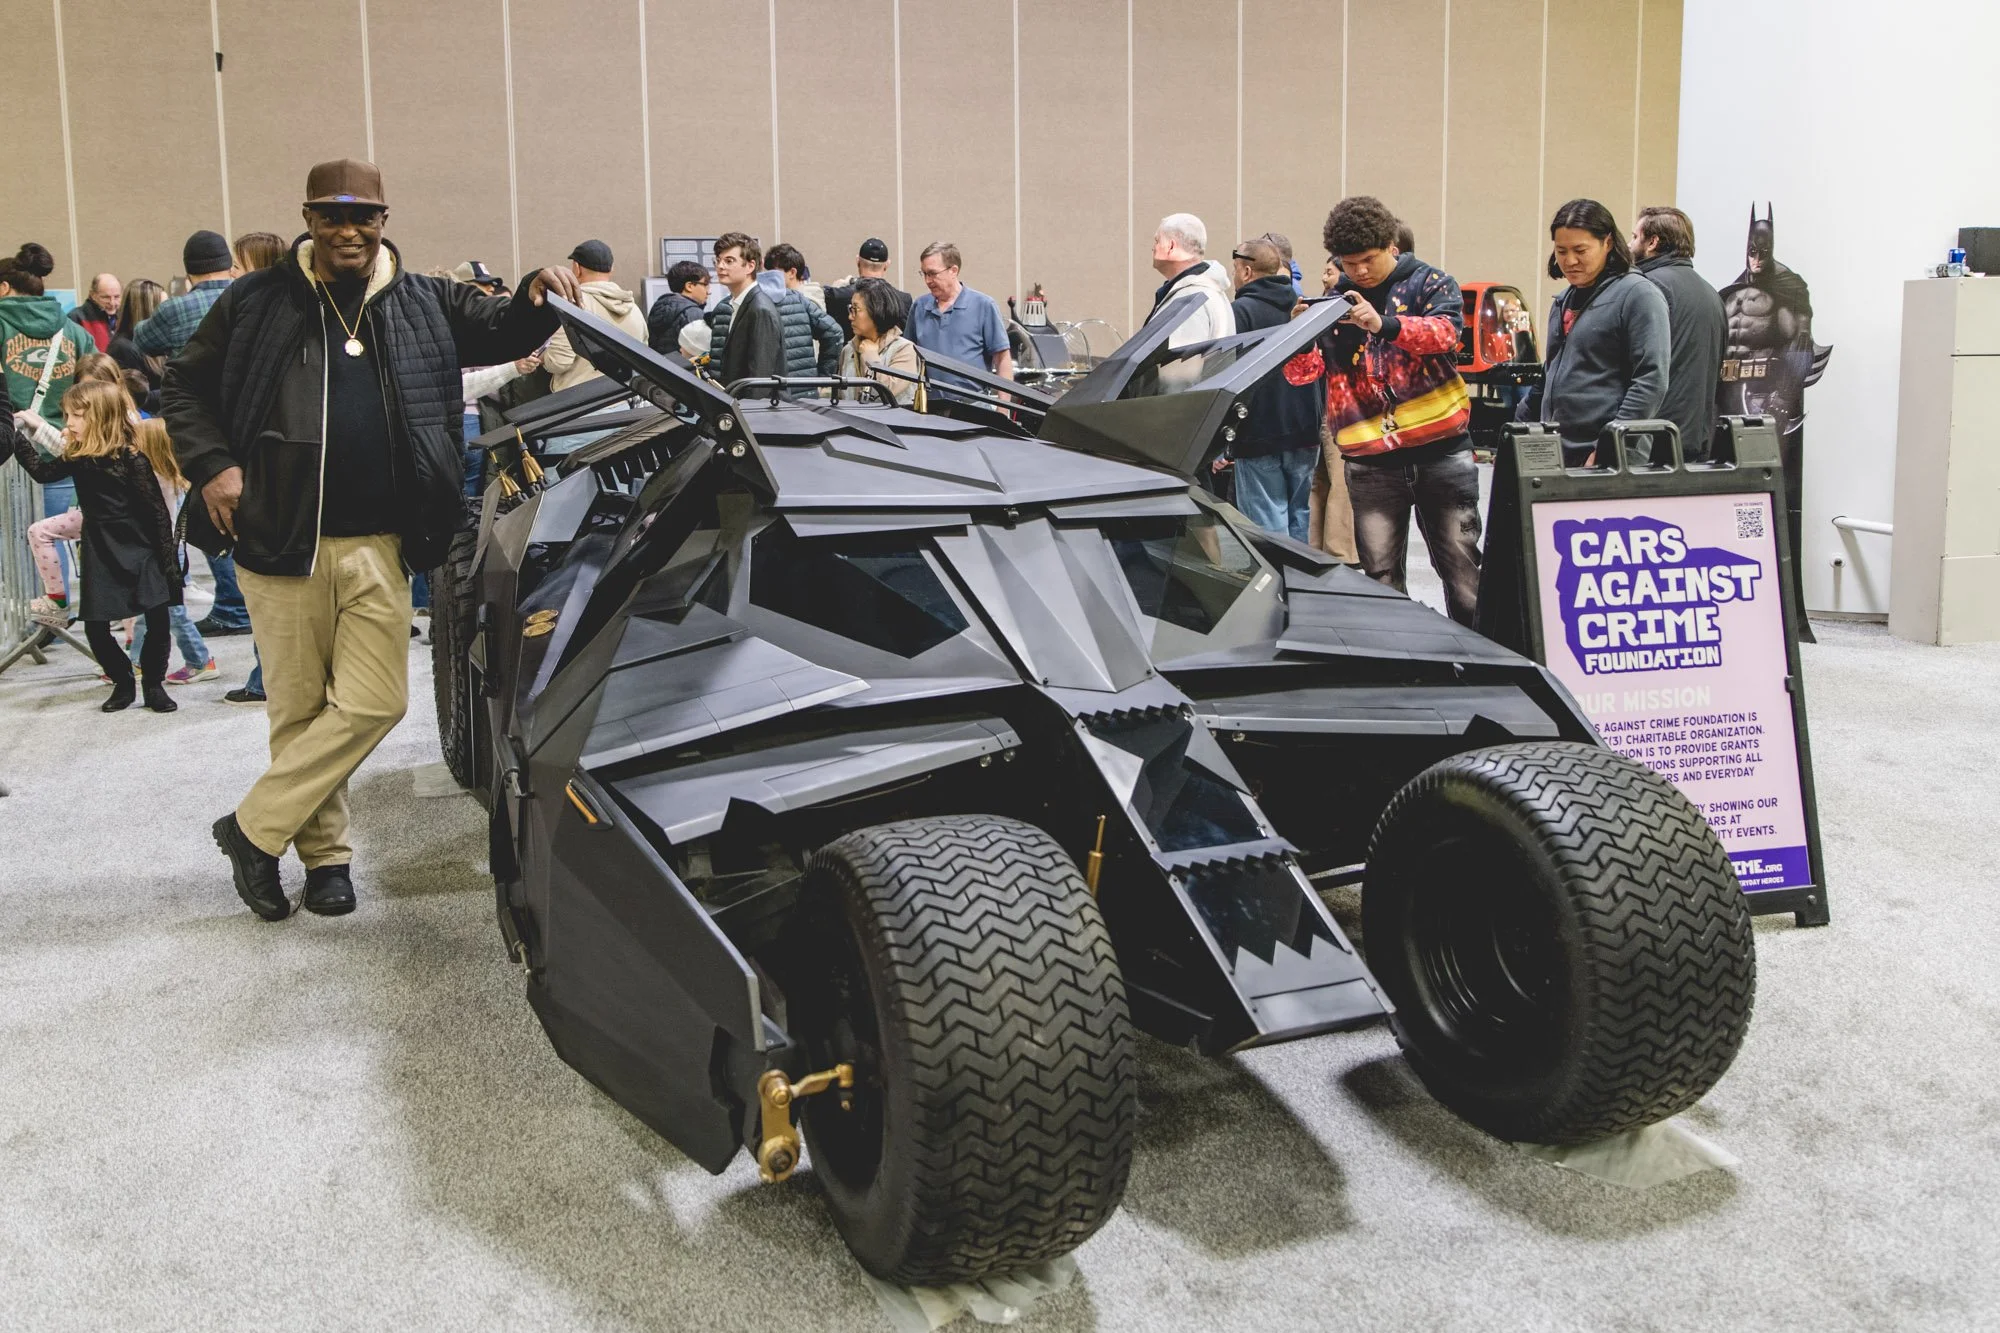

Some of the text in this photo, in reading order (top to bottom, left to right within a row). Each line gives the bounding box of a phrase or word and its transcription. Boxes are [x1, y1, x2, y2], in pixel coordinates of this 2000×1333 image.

[1570, 527, 1687, 567] CARS
[1573, 564, 1761, 608] AGAINST
[1577, 606, 1720, 649] CRIME
[1585, 646, 1721, 673] FOUNDATION
[1574, 685, 1712, 714] OUR MISSION
[1604, 720, 1646, 733] AGAINST
[1650, 717, 1680, 729] CRIME
[1683, 713, 1746, 727] FOUNDATION
[1748, 711, 1758, 722] IS
[1626, 730, 1687, 745] CHARITABLE
[1690, 725, 1766, 740] ORGANIZATION.
[1613, 738, 1760, 759] SION IS TO PROVIDE GRANTS
[1679, 755, 1742, 768] SUPPORTING
[1745, 753, 1763, 763] ALL
[1683, 770, 1702, 781] AND
[1705, 766, 1755, 780] EVERYDAY
[1709, 800, 1754, 812] SHOWING
[1757, 797, 1778, 808] OUR
[1706, 814, 1742, 826] ARS AT
[1737, 825, 1778, 838] EVENTS.
[1761, 876, 1785, 886] HEROES
